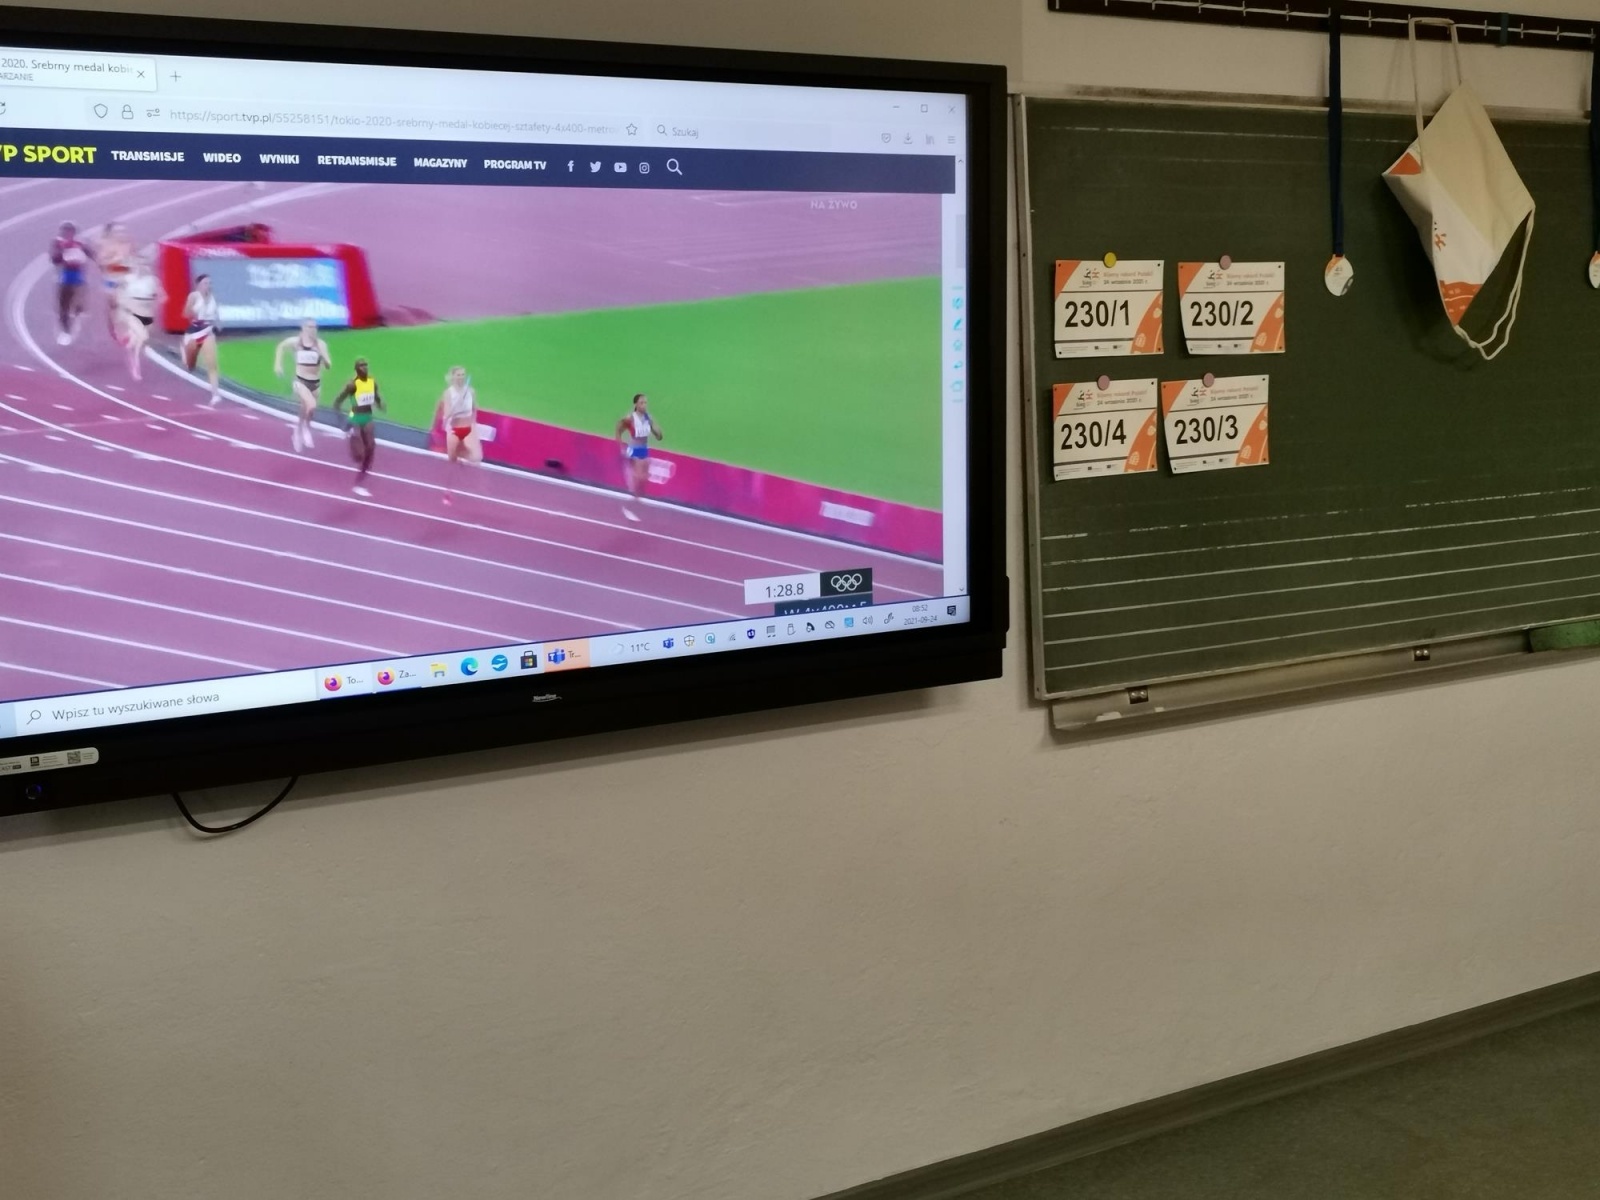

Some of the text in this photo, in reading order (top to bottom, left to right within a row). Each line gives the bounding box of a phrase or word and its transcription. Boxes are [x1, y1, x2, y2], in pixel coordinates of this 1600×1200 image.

[1, 57, 28, 69] 2020.
[31, 59, 70, 73] Srebrny
[73, 62, 105, 73] medal
[672, 127, 699, 140] Szukaj
[23, 144, 98, 164] SPORT
[111, 150, 547, 171] TRANSMISJE WIDEO WYNIKI RETRANSMISJE MAGAZYNY PROGRAM TV
[810, 198, 858, 210] NA ŻYWO
[1064, 300, 1130, 328] 230/1
[1190, 300, 1254, 327] 230/2
[1060, 419, 1127, 451] 230/4
[1174, 414, 1239, 445] 230/3
[765, 582, 804, 599] 1:28.8
[911, 603, 929, 613] 08:52
[903, 614, 938, 626] 2021-09-24
[630, 642, 650, 653] 11°C
[52, 692, 220, 722] Wpisz tu wyszukiwane słowa
